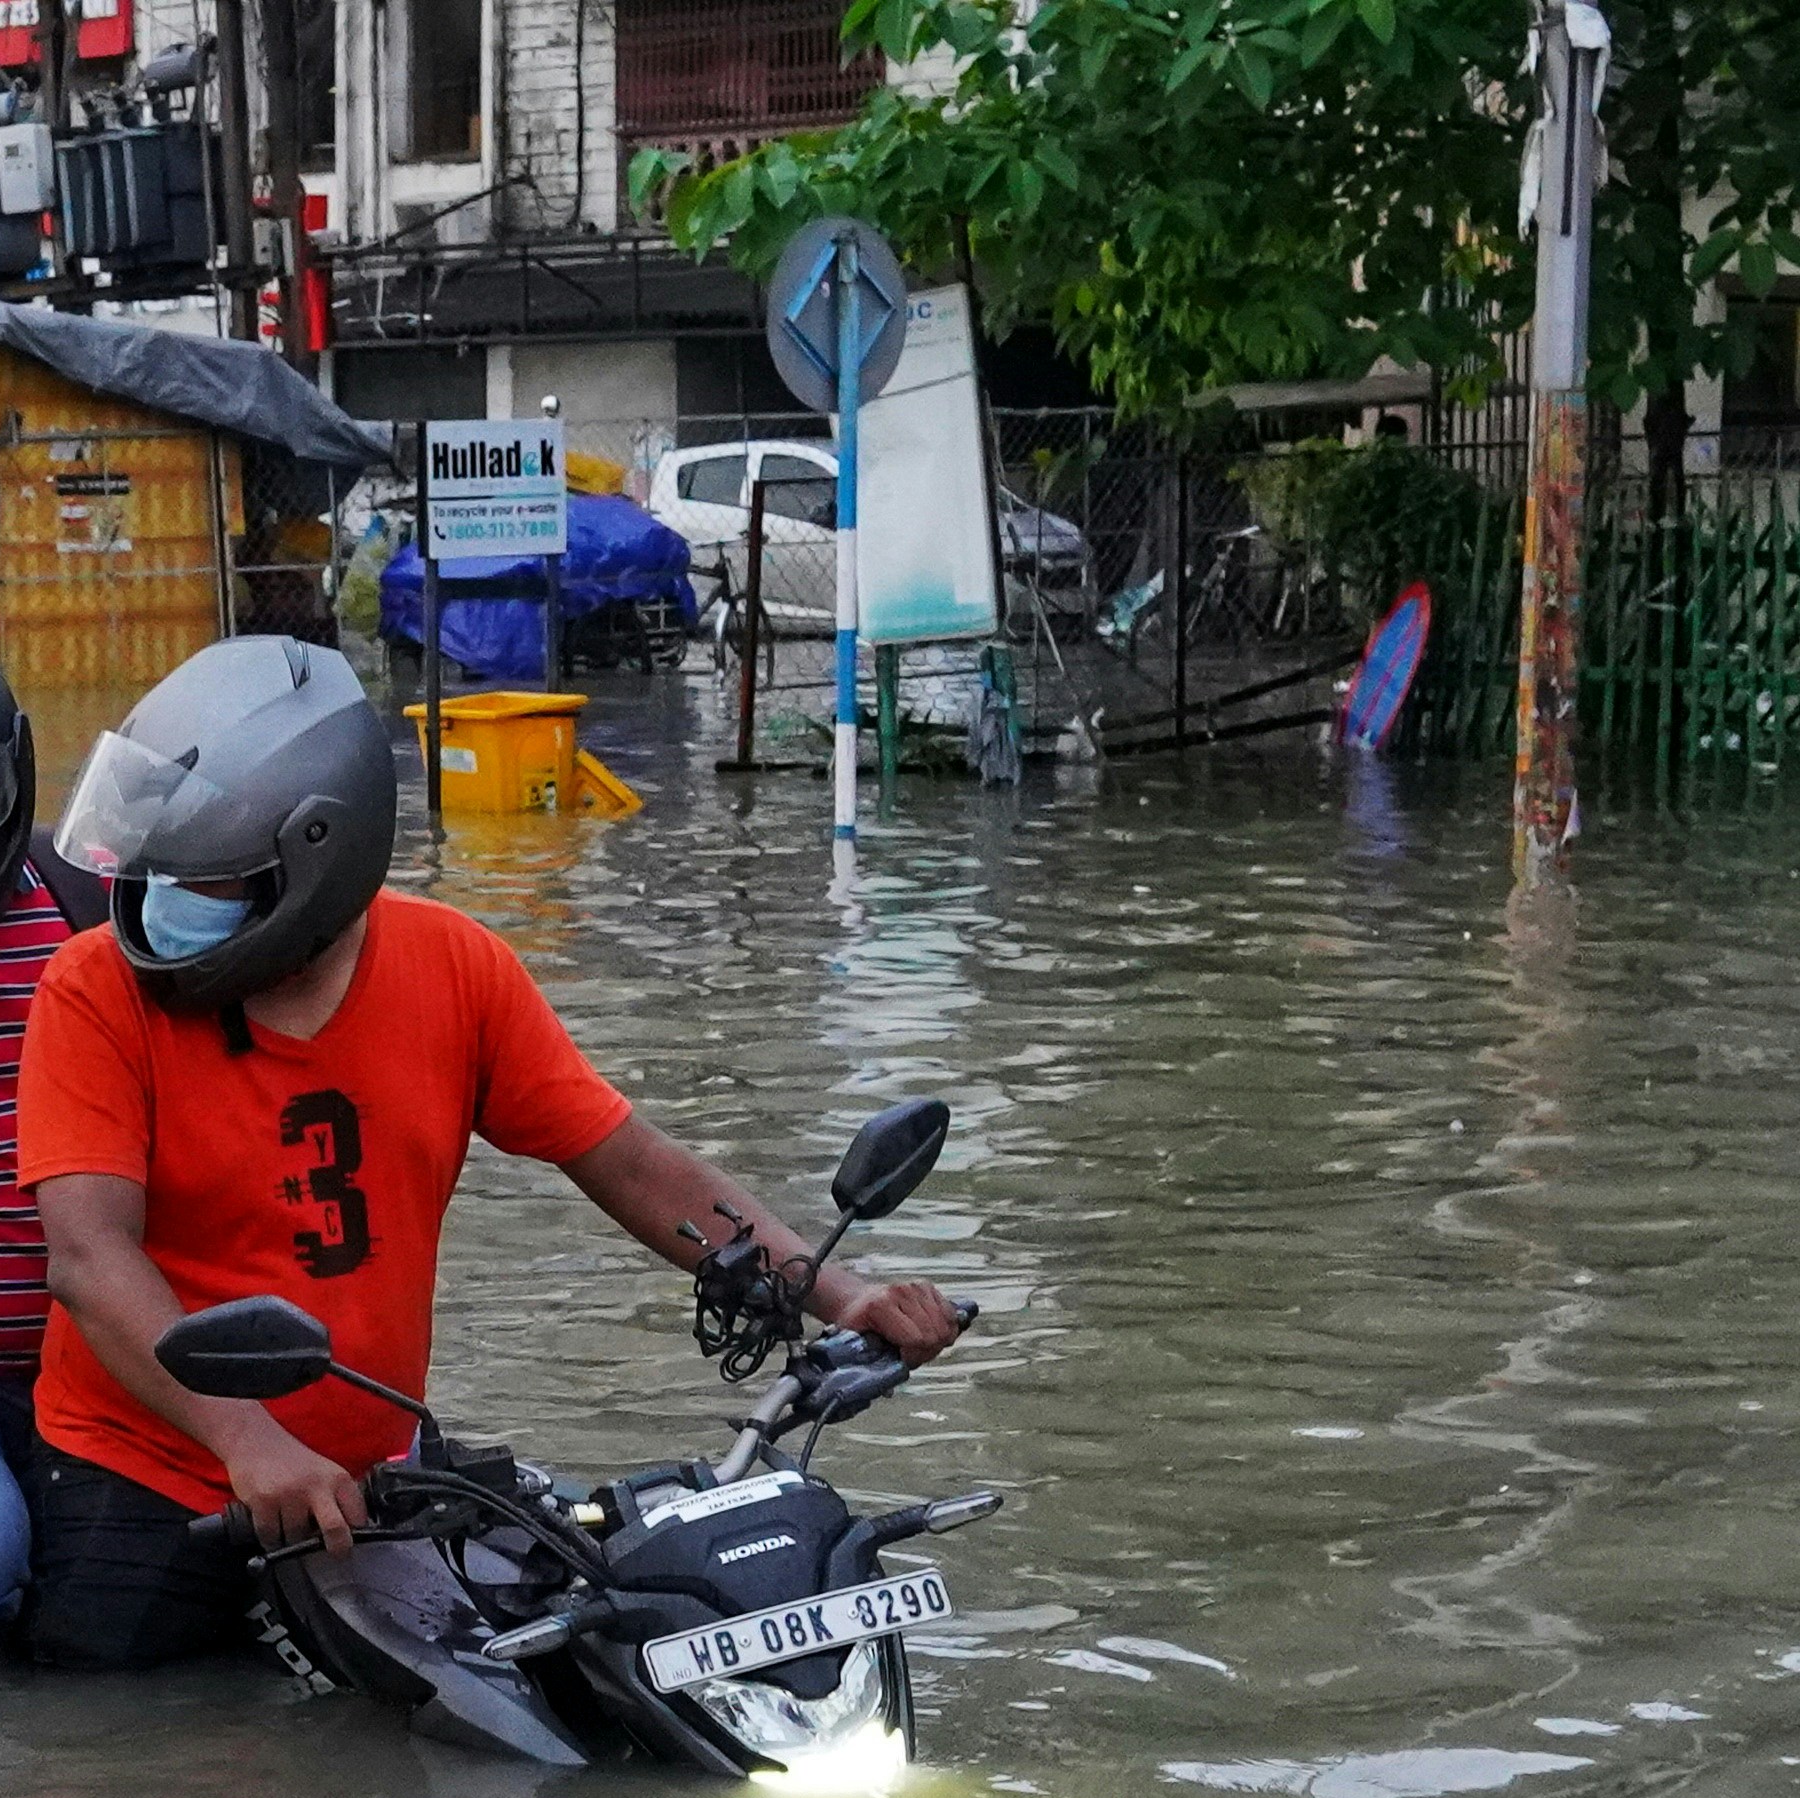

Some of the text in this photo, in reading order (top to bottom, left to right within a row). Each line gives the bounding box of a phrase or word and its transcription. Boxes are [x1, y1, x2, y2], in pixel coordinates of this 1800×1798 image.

[432, 438, 555, 480] Hulladek
[280, 1088, 370, 1279] 3
[717, 1534, 797, 1565] HONDA
[688, 1578, 945, 1675] WB 08K 8290
[672, 1667, 693, 1681] IND
